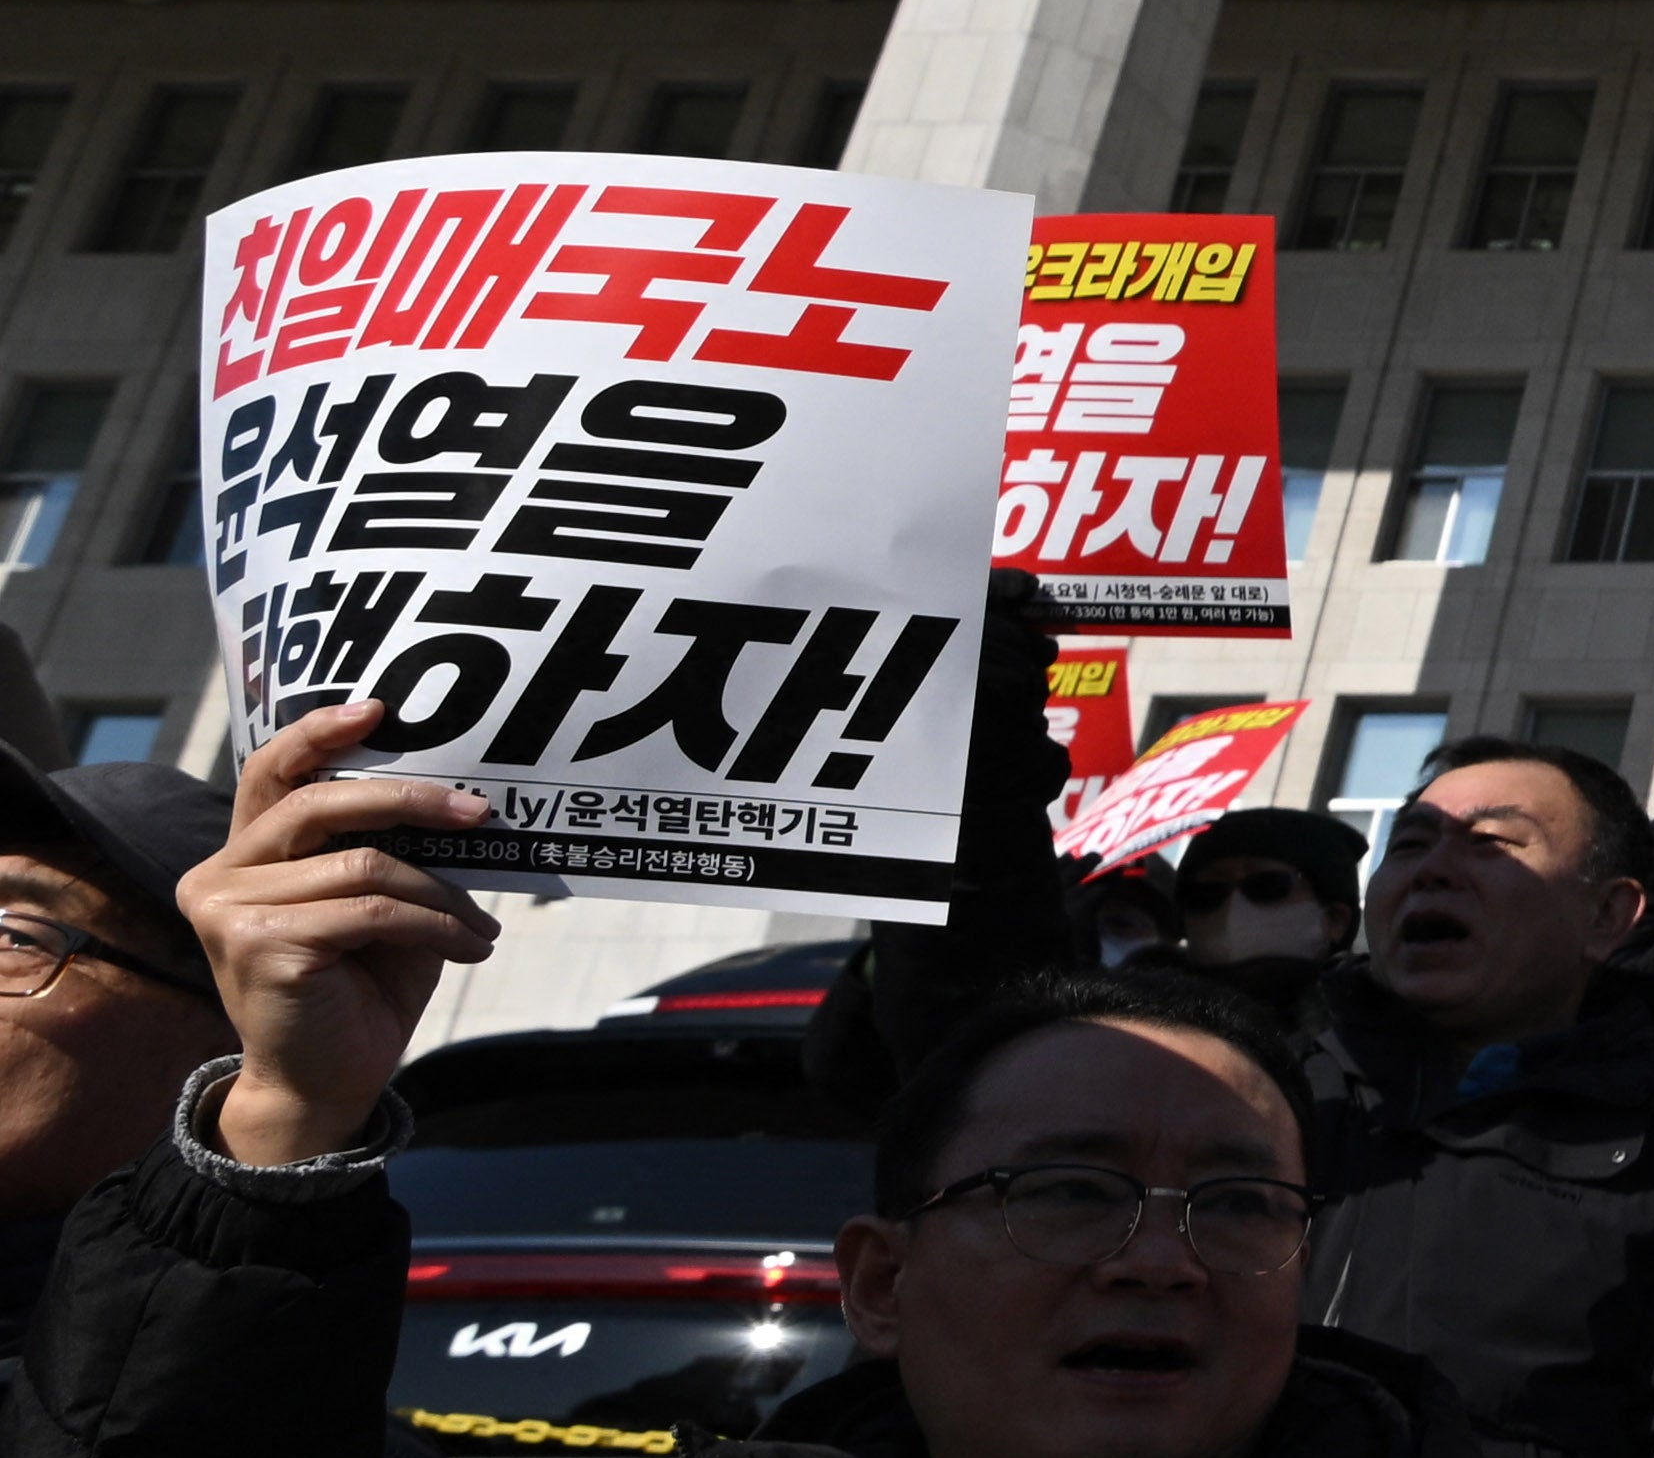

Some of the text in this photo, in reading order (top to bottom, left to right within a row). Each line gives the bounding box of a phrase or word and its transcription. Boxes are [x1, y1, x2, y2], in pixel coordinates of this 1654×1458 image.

[213, 184, 950, 399] 친일매국노
[215, 370, 788, 595] 윤석열을
[991, 448, 1268, 564] 하자!
[1037, 582, 1088, 600] 토요일
[1231, 585, 1270, 604] 대로)
[242, 571, 960, 790] 탄핵하자!
[529, 841, 756, 880] (촛불승리전환행동)
[448, 1322, 592, 1357] KIA
